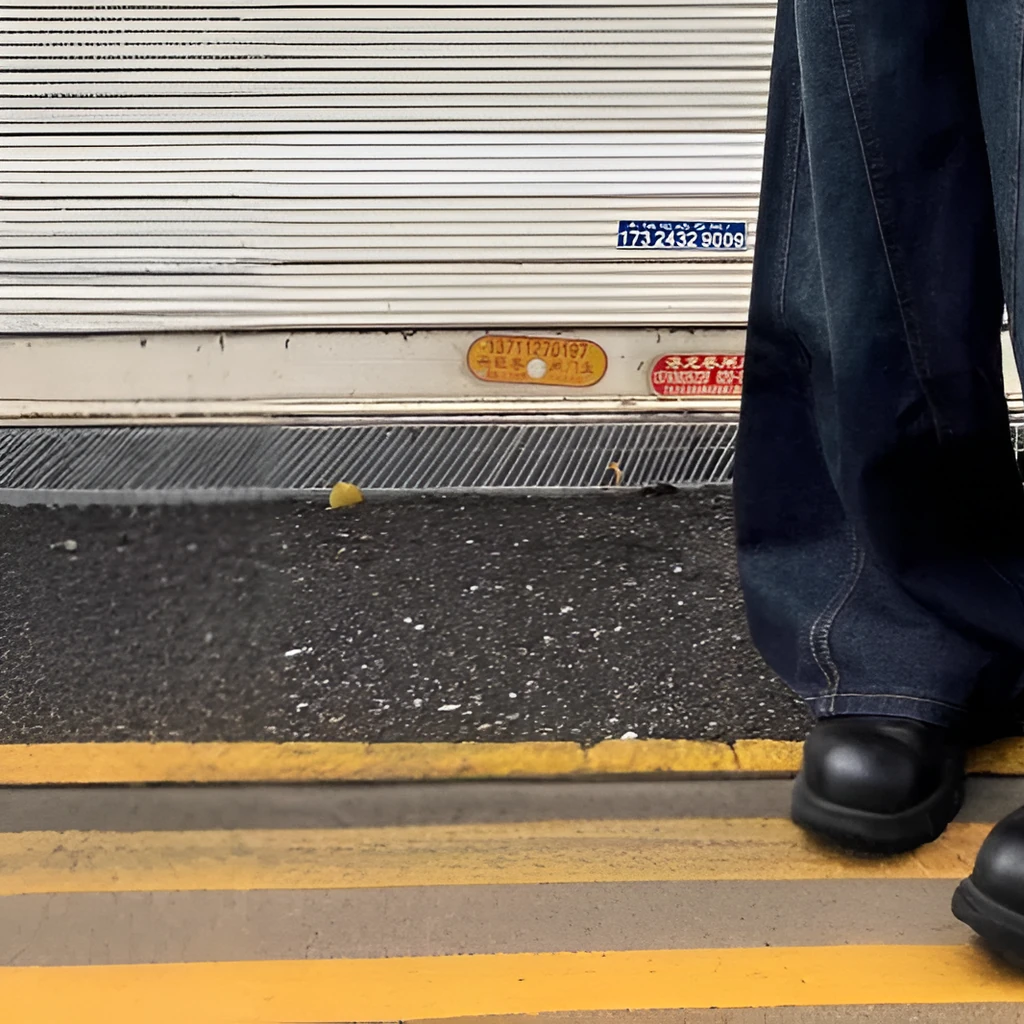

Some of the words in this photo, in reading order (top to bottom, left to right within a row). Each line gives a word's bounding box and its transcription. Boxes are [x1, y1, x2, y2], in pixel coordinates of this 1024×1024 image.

[619, 231, 651, 247] 173
[655, 230, 698, 248] 2432
[701, 232, 744, 248] 9009
